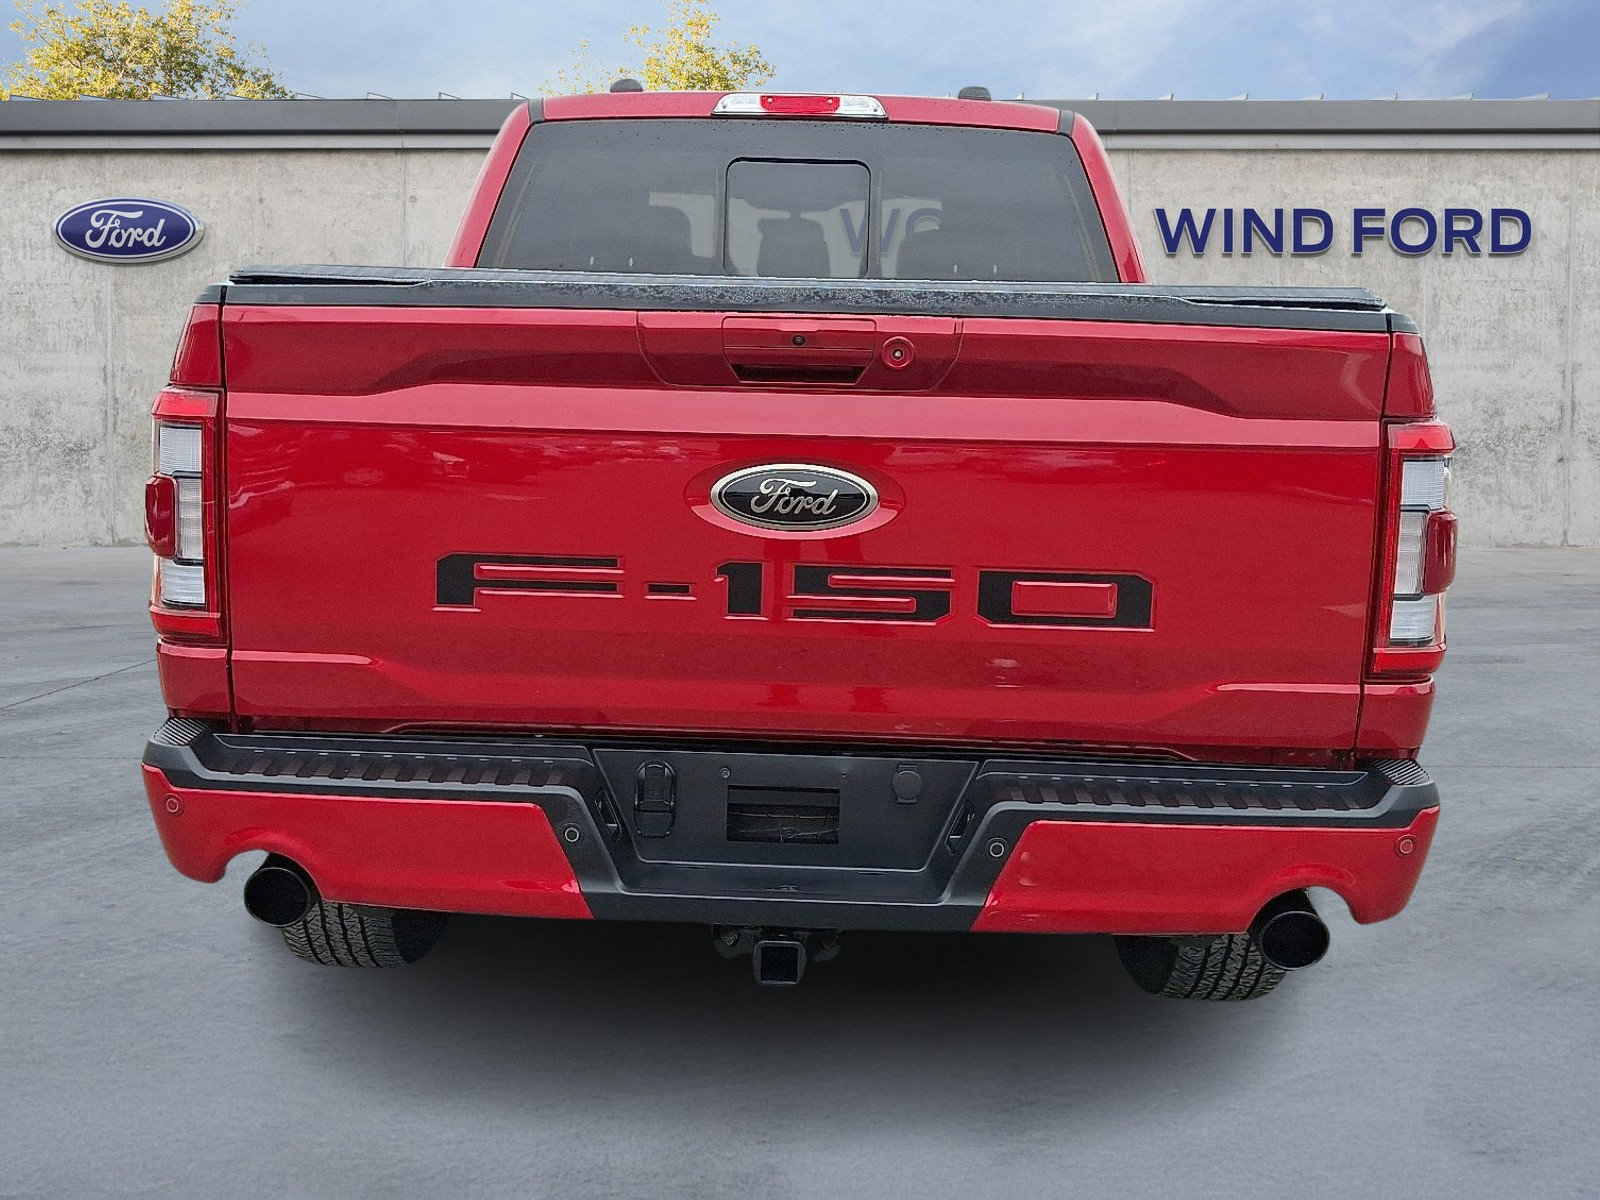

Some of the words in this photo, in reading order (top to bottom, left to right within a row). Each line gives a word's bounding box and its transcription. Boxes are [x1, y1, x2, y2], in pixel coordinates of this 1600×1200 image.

[85, 209, 167, 248] Ford
[1154, 207, 1334, 255] WIND
[1351, 207, 1532, 255] FORD
[750, 478, 839, 515] Ford
[433, 552, 1155, 632] F-150
